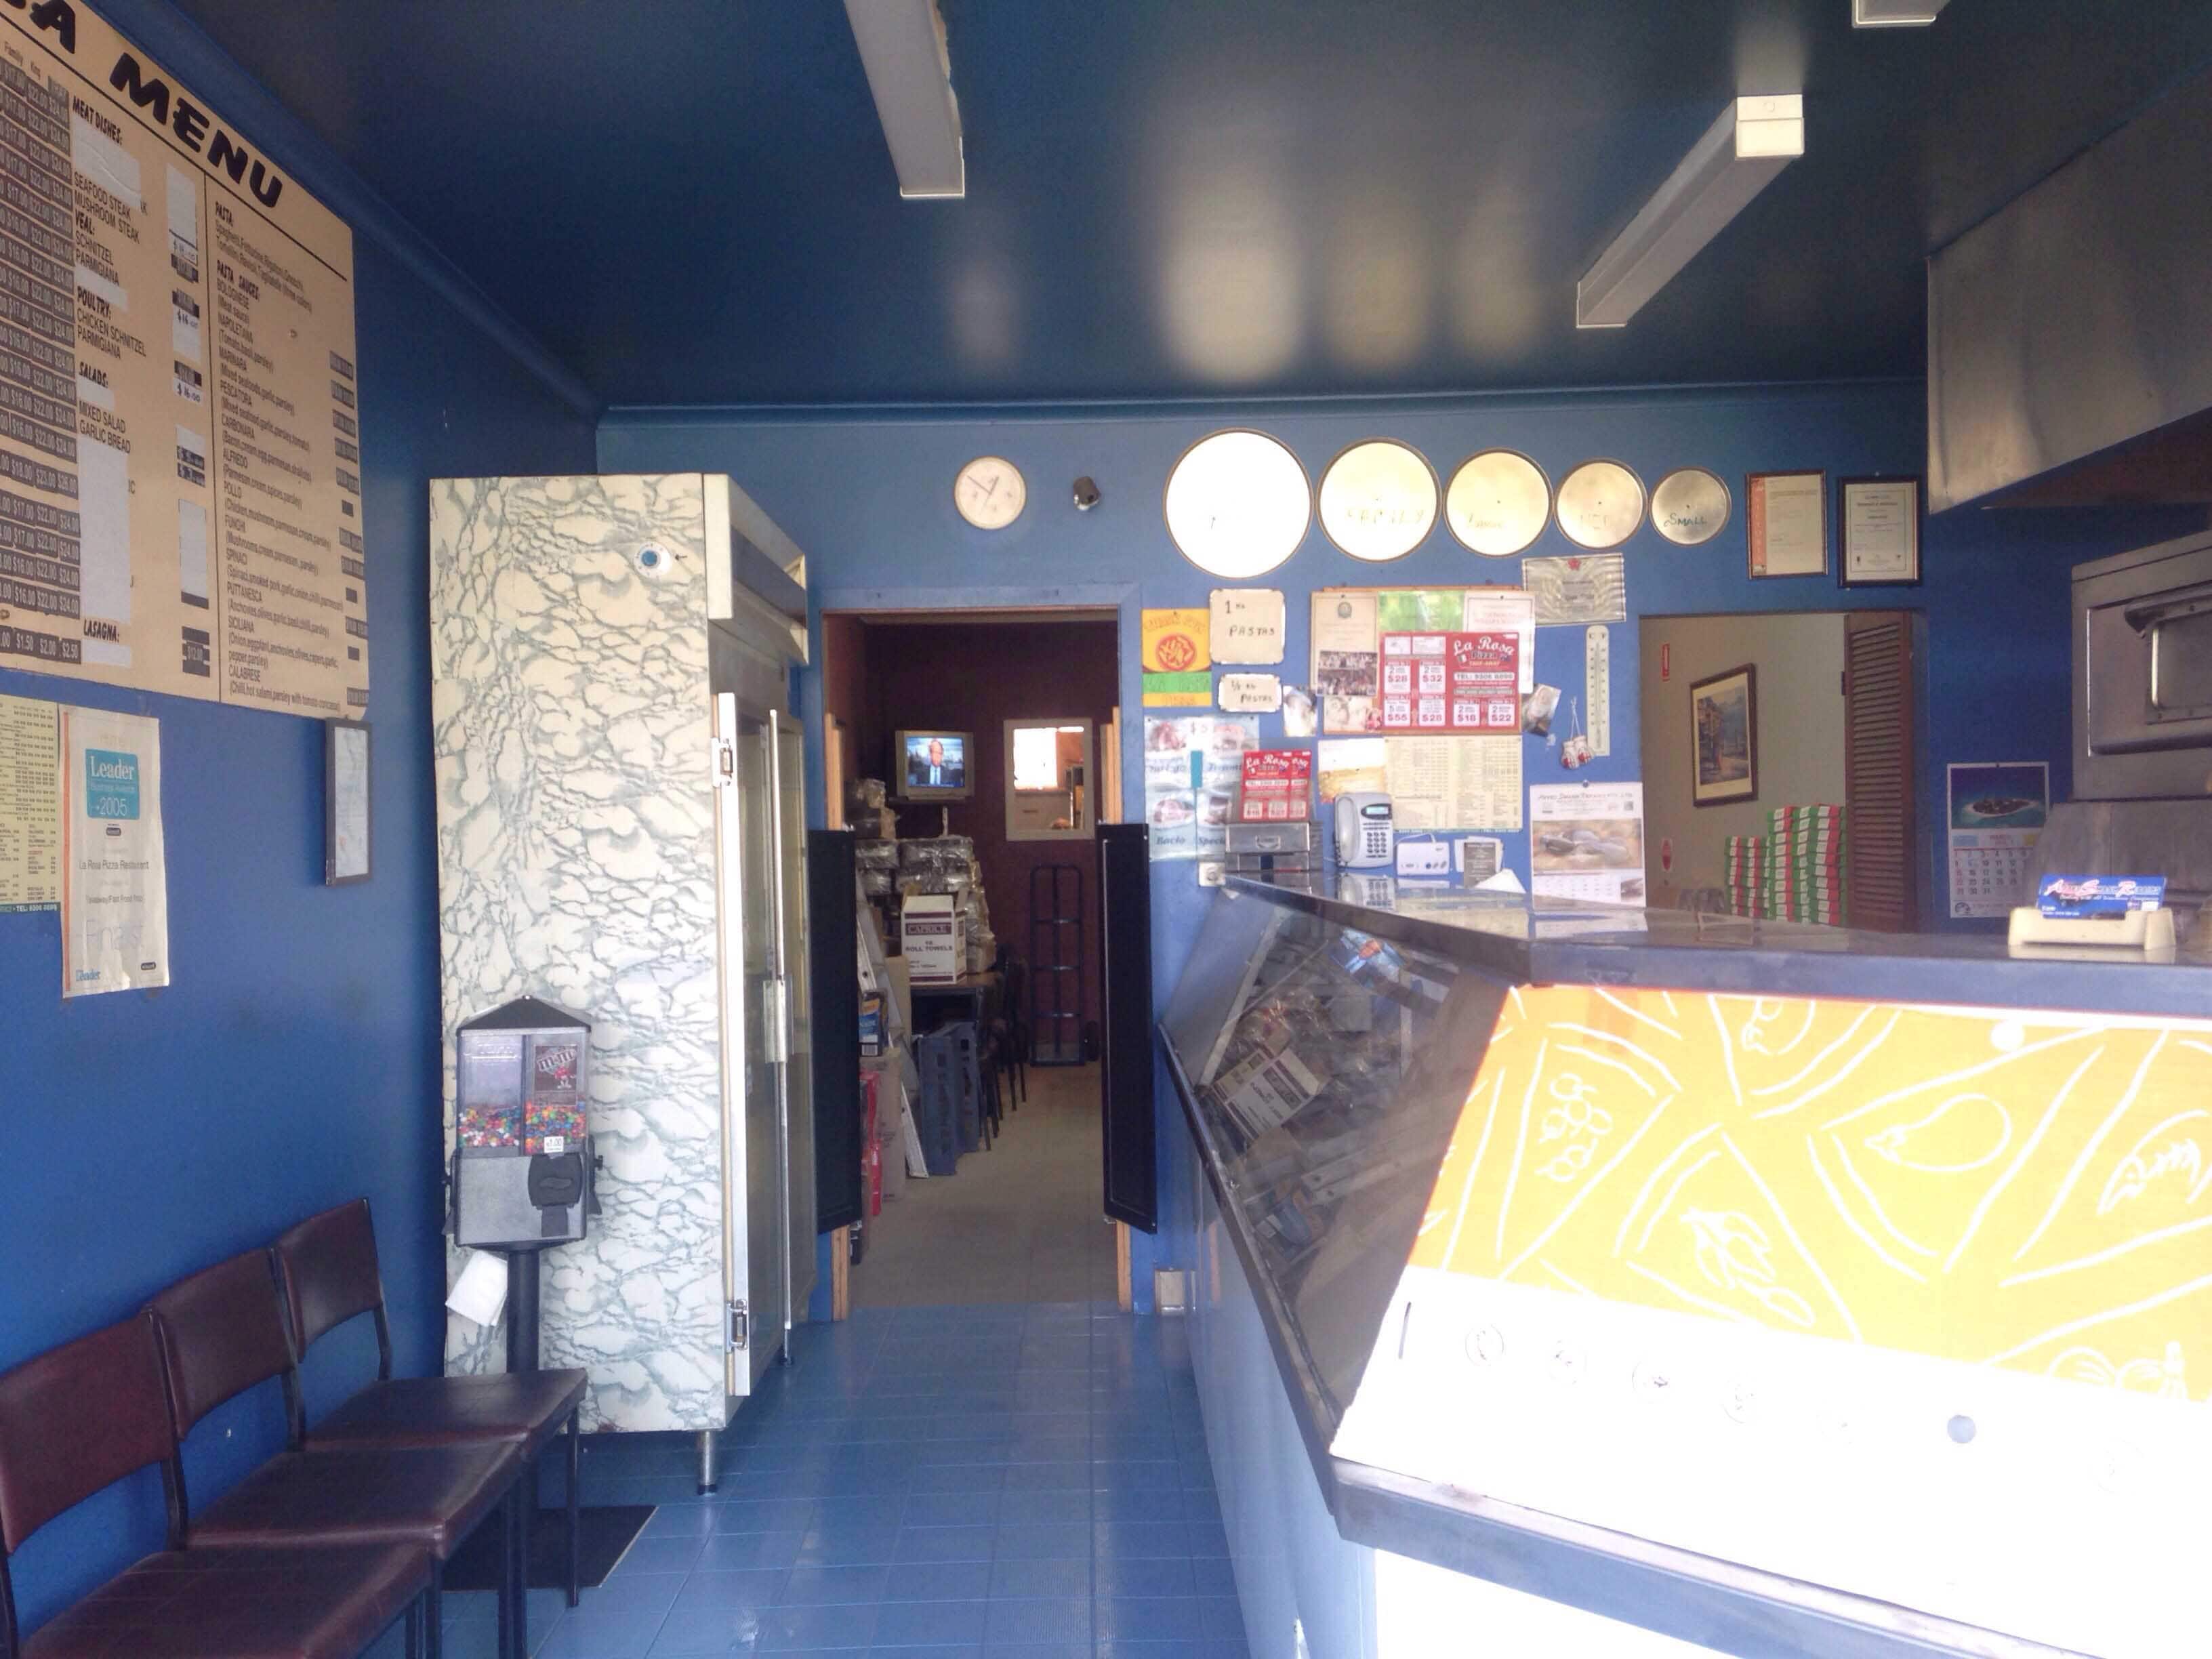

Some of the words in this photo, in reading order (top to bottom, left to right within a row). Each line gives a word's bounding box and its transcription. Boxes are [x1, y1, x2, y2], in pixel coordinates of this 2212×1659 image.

[73, 95, 94, 125] MEAT
[96, 114, 123, 146] DISHES:
[109, 52, 283, 208] MENU
[74, 171, 108, 205] SEAFOOD
[109, 194, 131, 220] STEAK
[74, 190, 116, 228] MUSHROOM
[119, 218, 140, 244] STEAK
[75, 209, 95, 236] VEAL:
[75, 230, 114, 266] SCHNITZEL
[75, 248, 120, 286] PARMIGIANA
[217, 259, 234, 284] PASTA
[77, 285, 111, 320] POULTRY:
[77, 307, 108, 336] CHICKEN
[110, 327, 147, 357] SCHNITZEL
[77, 325, 122, 360] PARMIGIANA
[79, 361, 108, 389] SALADS:
[79, 419, 106, 442] GARLIC
[107, 430, 131, 454] BREAD
[102, 411, 126, 434] SALAD
[83, 619, 120, 643] LASAGNA:
[1229, 625, 1275, 637] PASTAS
[1453, 640, 1473, 656] La
[1477, 635, 1515, 655] Rosa
[1240, 693, 1273, 704] PASTAS
[90, 756, 135, 779] Leader
[99, 796, 127, 817] 2005
